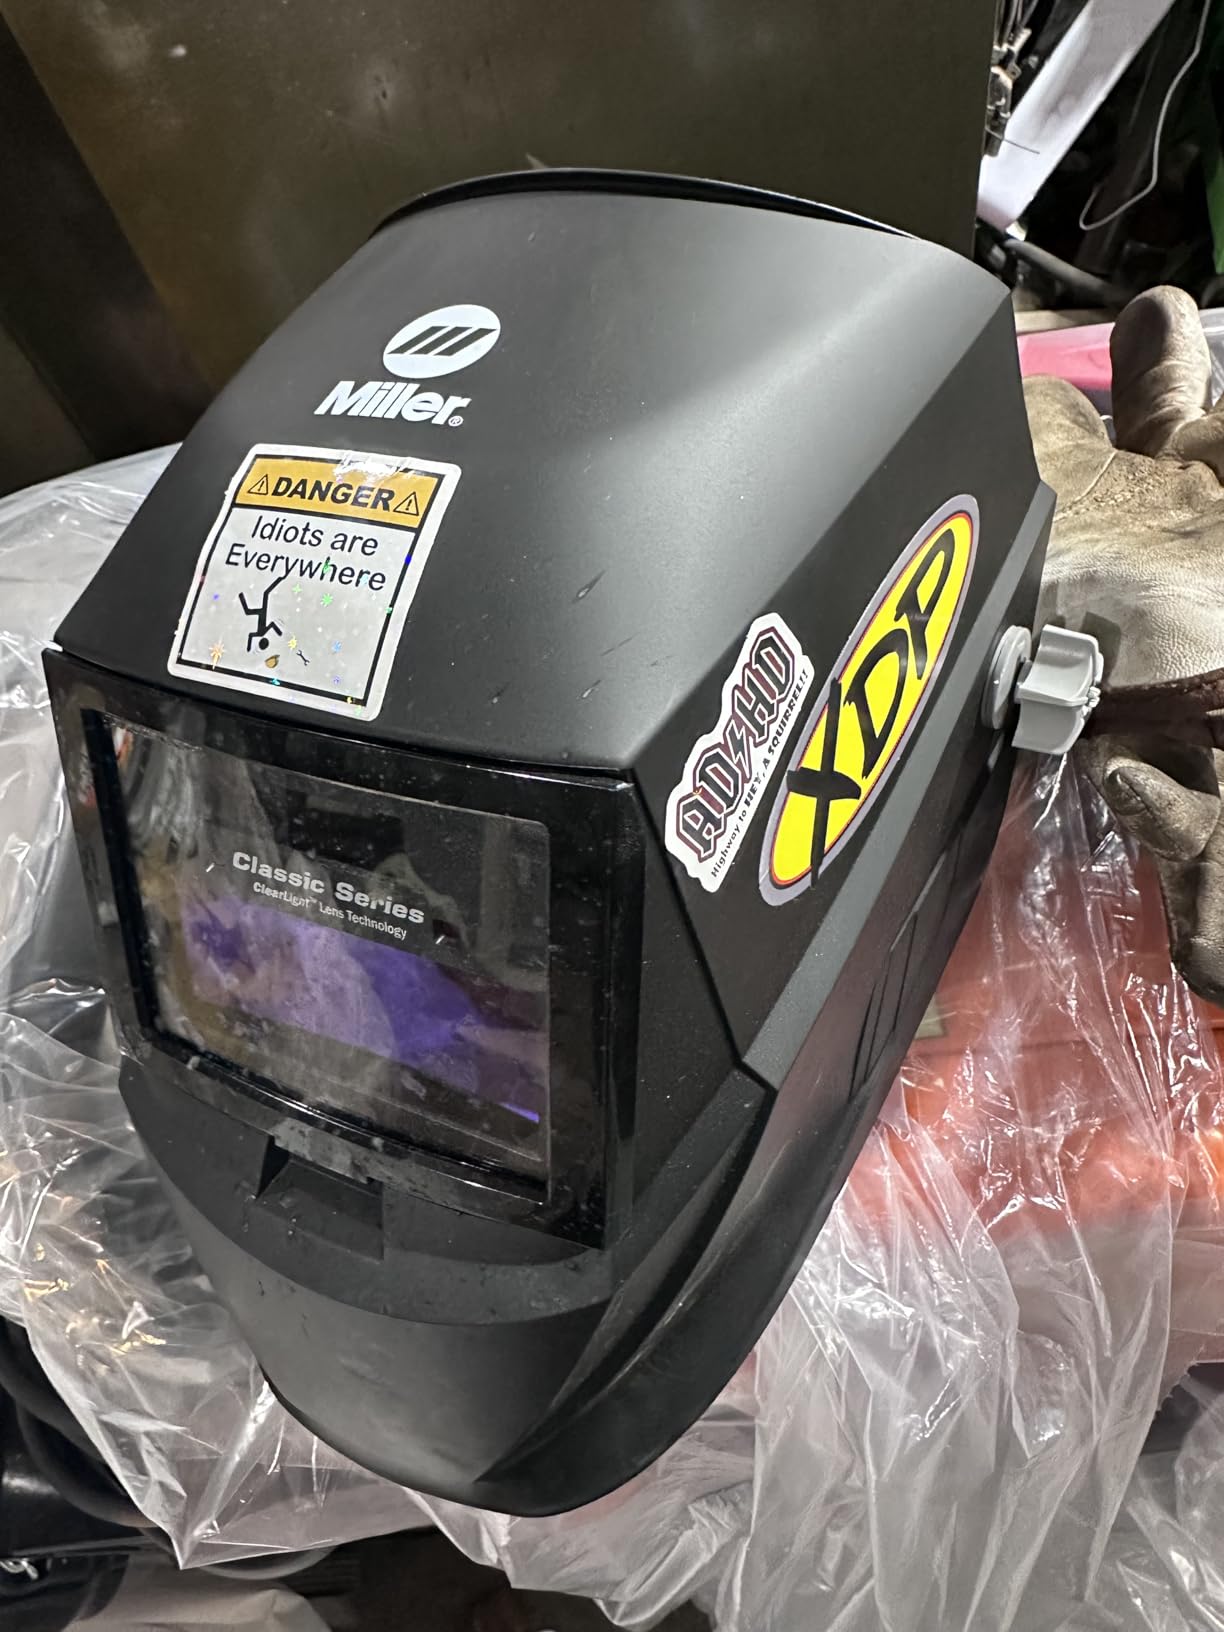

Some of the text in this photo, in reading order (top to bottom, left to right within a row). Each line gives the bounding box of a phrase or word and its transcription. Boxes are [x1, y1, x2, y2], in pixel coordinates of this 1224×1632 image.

[271, 475, 396, 512] DANGER
[250, 515, 379, 556] Idiots are
[225, 543, 387, 591] Everywhere
[786, 528, 956, 889] XDP
[711, 823, 741, 878] Highway
[738, 809, 747, 822] to
[762, 758, 771, 770] A
[767, 669, 808, 756] SQUIRREL!!
[232, 851, 425, 924] Classic Series
[319, 900, 345, 919] Lens
[346, 911, 407, 941] Technology
